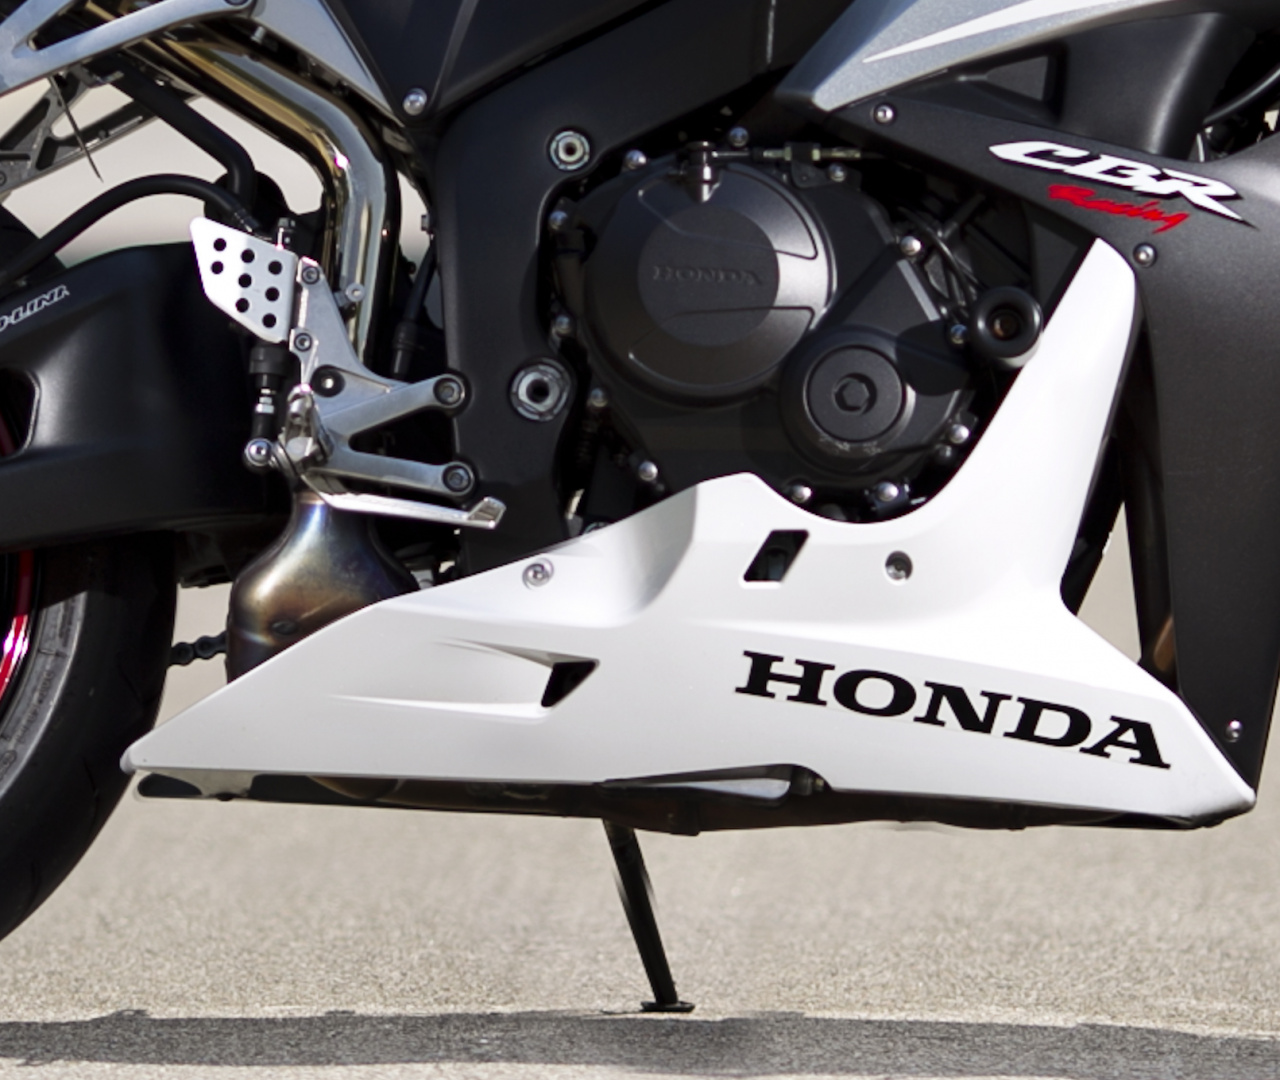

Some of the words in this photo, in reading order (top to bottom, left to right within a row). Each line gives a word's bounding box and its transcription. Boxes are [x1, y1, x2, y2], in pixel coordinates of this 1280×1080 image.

[988, 140, 1248, 223] CBR
[651, 266, 763, 287] HONDA
[734, 650, 1172, 770] HONDA
